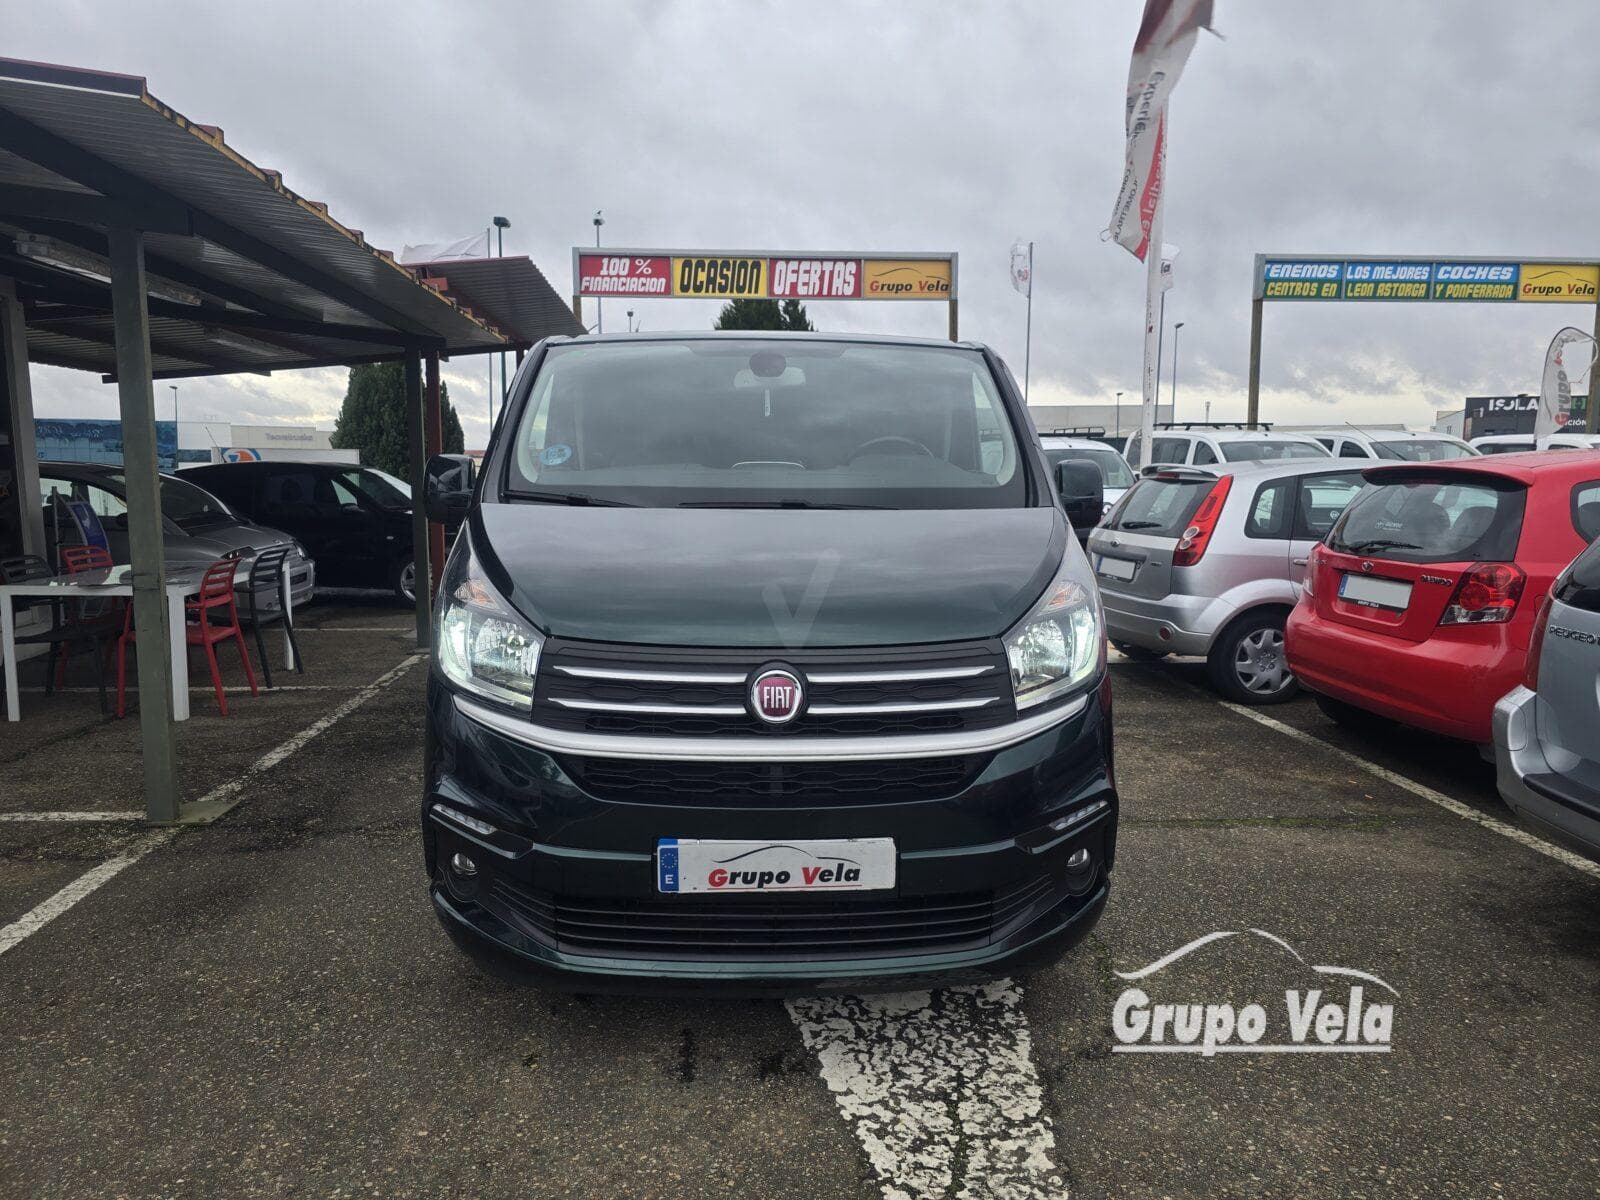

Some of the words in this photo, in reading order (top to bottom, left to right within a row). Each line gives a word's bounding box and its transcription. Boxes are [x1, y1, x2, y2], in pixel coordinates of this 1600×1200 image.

[600, 257, 630, 276] 100
[634, 258, 652, 275] %
[1346, 265, 1371, 280] LOS
[1372, 266, 1430, 280] MEJORES
[1437, 266, 1514, 280] COCHES
[580, 276, 667, 293] FINANCIACION
[680, 259, 762, 294] OCASION
[773, 260, 857, 296] OFERTAS
[869, 280, 913, 294] Grupo
[918, 280, 950, 292] Vela
[1266, 282, 1319, 297] CENTROS
[1321, 283, 1338, 297] EN
[1346, 283, 1375, 297] LEON
[1376, 283, 1427, 298] ASTORGA
[1434, 284, 1445, 298] Y
[1445, 284, 1514, 299] PONFERRADA
[1522, 283, 1562, 296] Grupo
[1567, 283, 1595, 295] Vela
[763, 686, 792, 709] FIAT
[665, 874, 674, 885] E
[708, 868, 791, 889] Grupo
[801, 863, 861, 884] Vela
